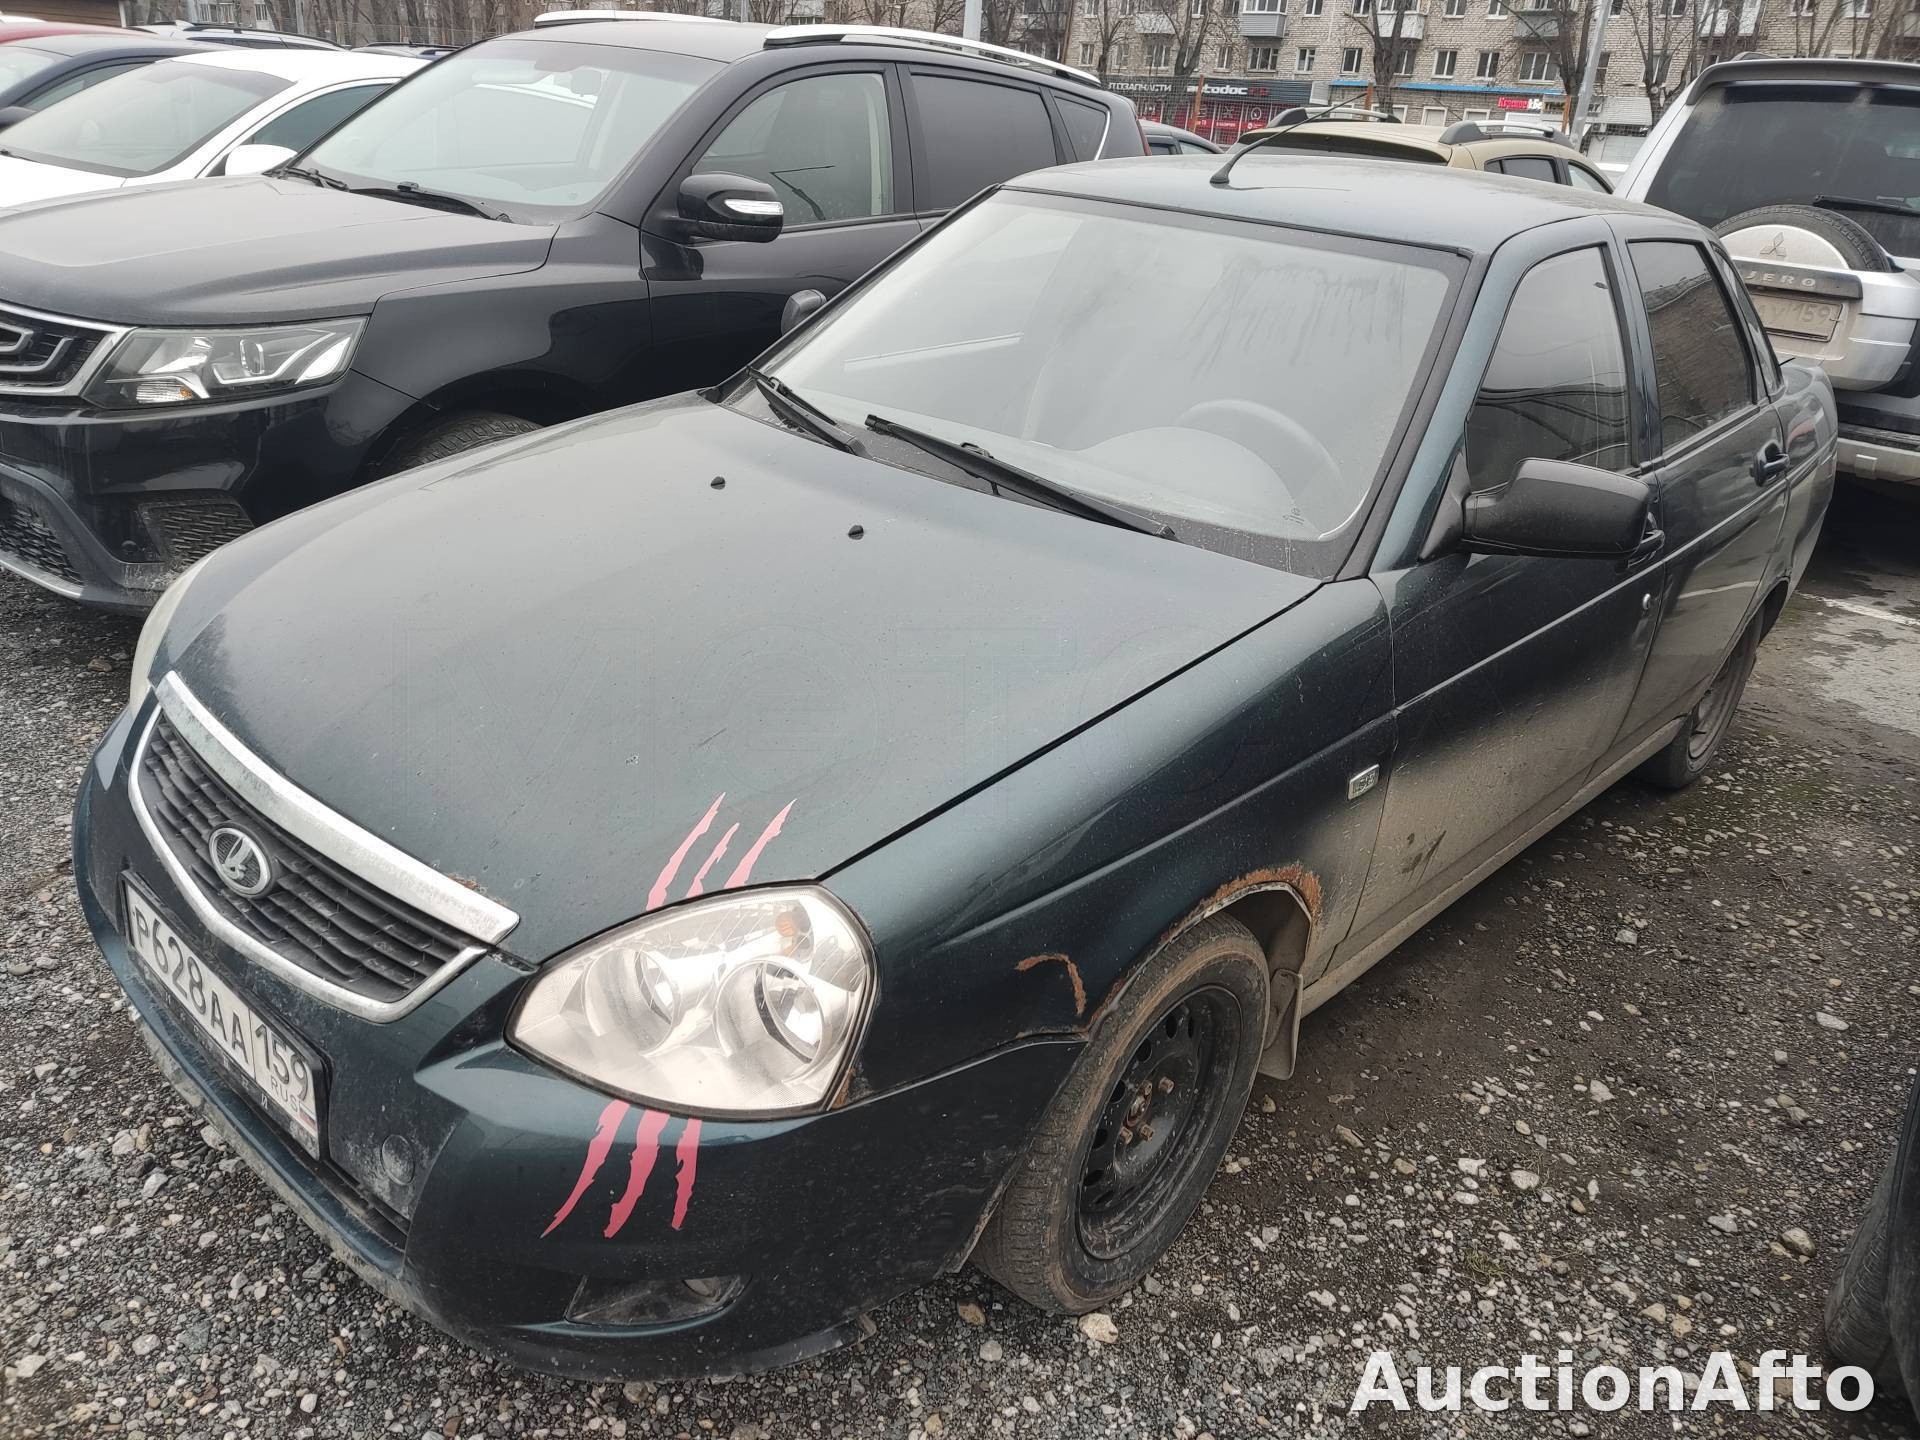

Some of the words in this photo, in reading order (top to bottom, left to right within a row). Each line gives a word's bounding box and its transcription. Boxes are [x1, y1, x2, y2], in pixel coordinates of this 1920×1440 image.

[1746, 270, 1816, 287] JERO
[255, 1022, 310, 1102] 159
[270, 1075, 301, 1114] RUS
